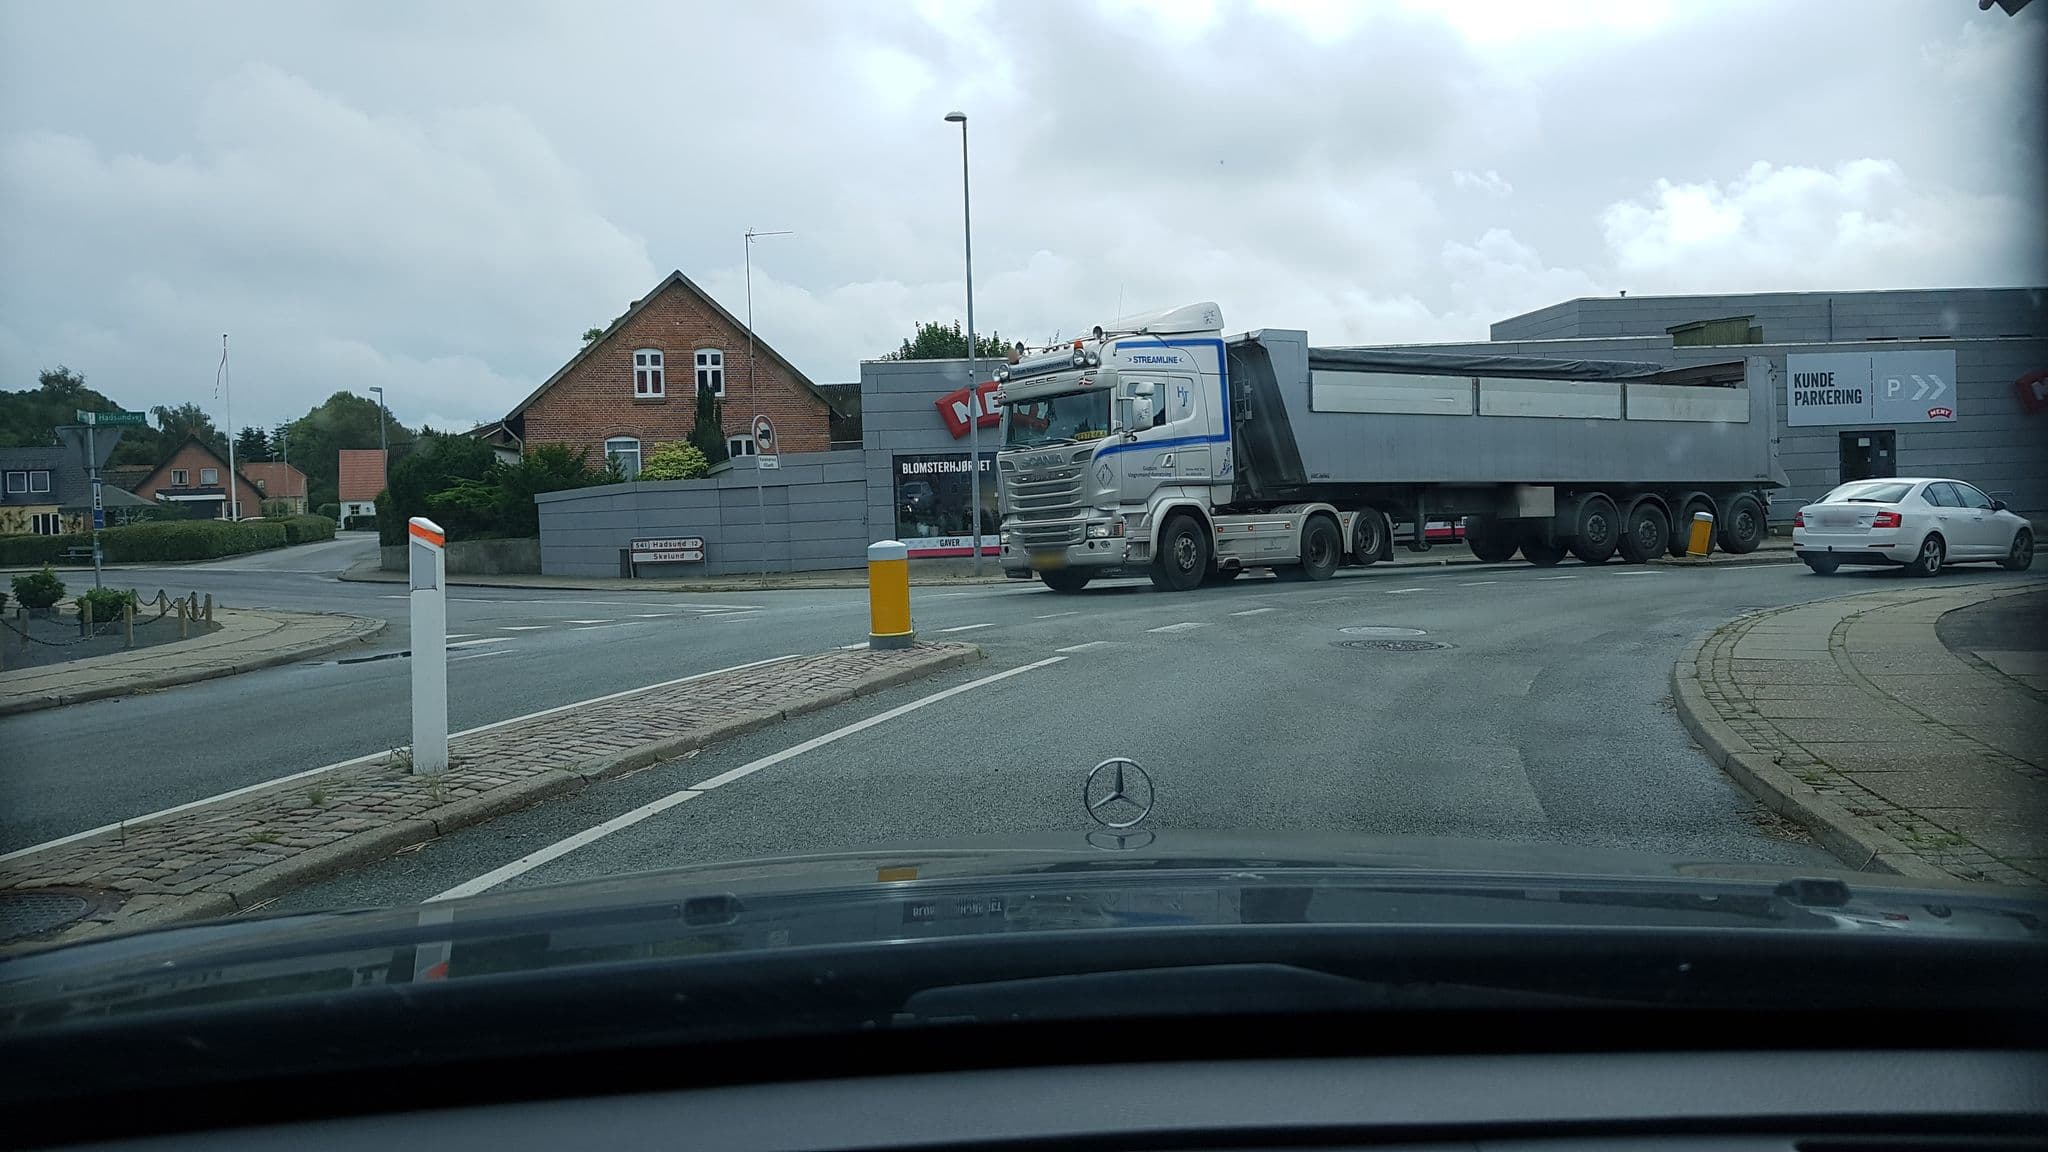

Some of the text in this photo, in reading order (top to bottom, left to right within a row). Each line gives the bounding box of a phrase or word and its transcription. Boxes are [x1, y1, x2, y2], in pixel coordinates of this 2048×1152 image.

[1133, 355, 1178, 364] STREAMLINE
[1794, 372, 1835, 388] KUNDE
[1887, 379, 1901, 397] P
[1794, 388, 1863, 406] PARKERING
[902, 460, 991, 474] BLOMSTERHJØRET
[652, 540, 687, 548] Hadsund
[691, 540, 699, 548] 12
[939, 538, 961, 547] GAVER
[653, 552, 685, 560] Skelund
